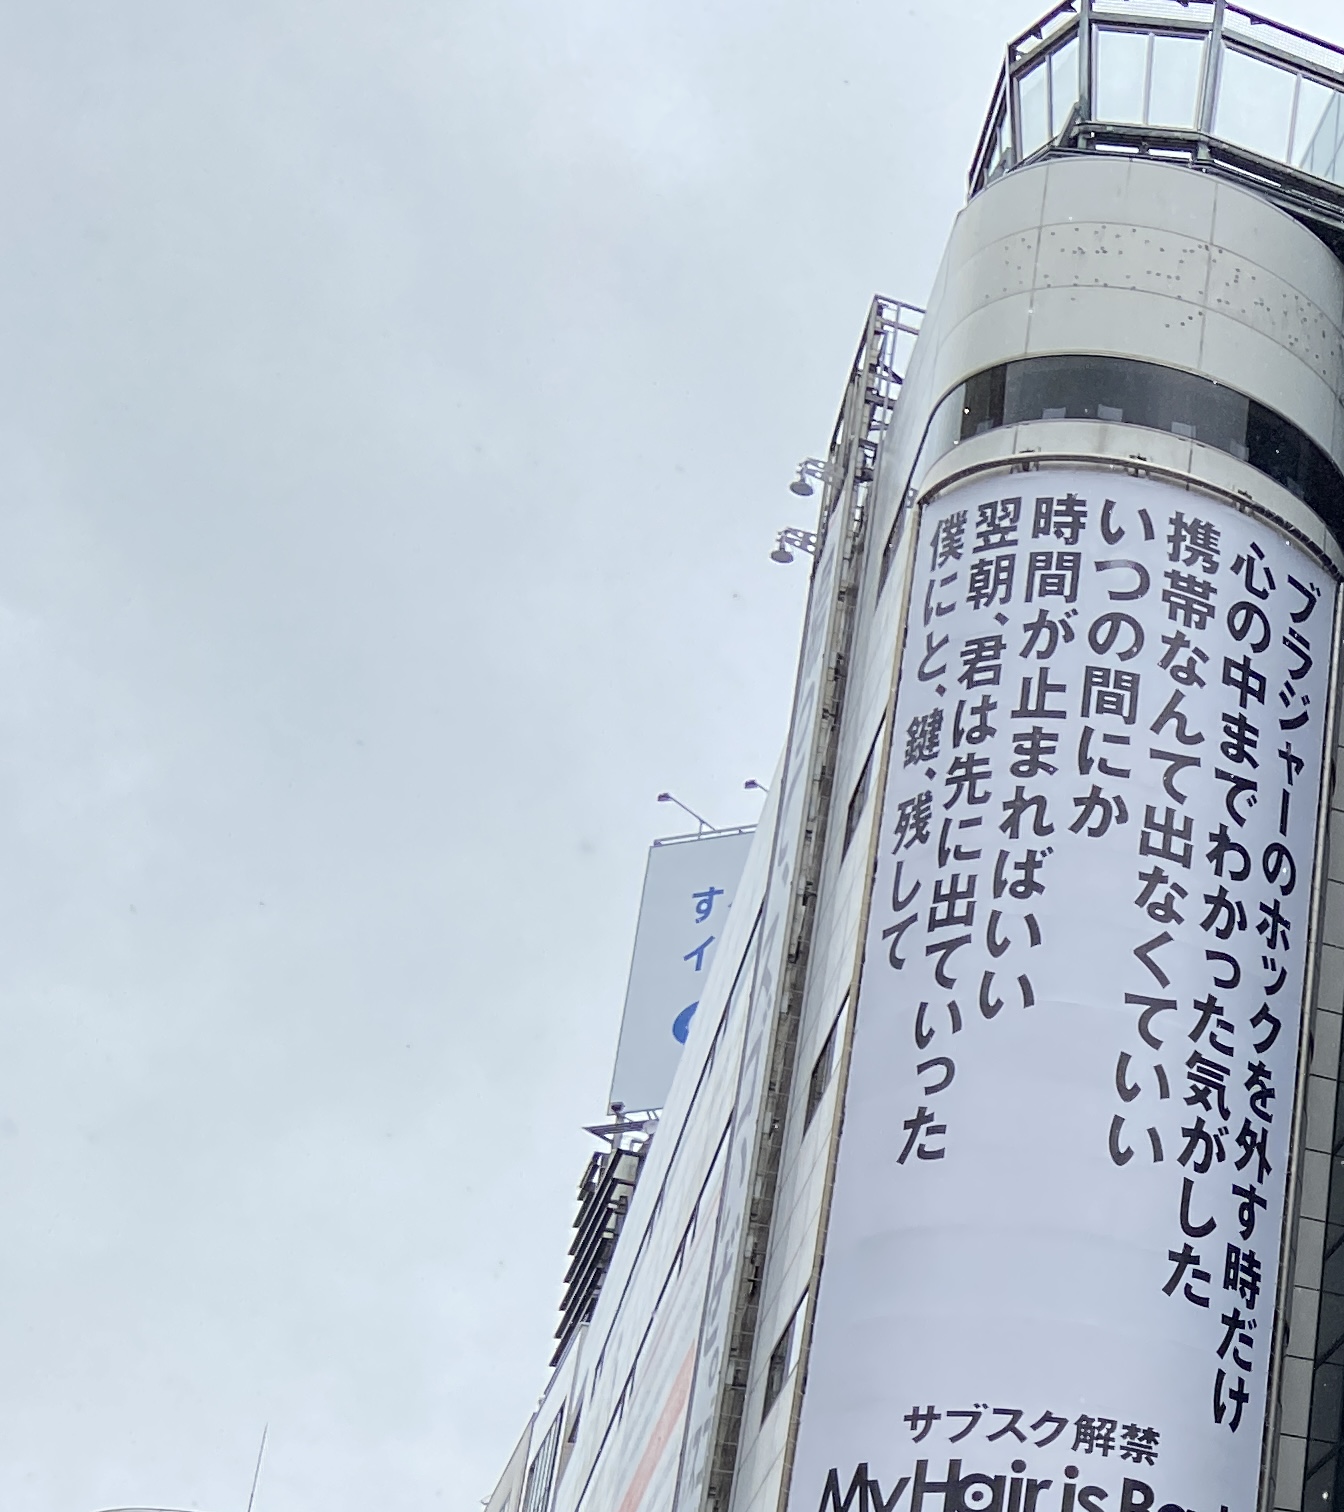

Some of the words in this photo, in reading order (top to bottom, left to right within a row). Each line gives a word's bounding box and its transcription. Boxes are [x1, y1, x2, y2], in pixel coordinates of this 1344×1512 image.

[881, 508, 968, 971] 僕にと、鍵、残して
[896, 495, 1023, 1165] 翌朝、君は先に出ていった
[979, 491, 1088, 1021] 時間が止まればいい
[1068, 497, 1155, 839] いつの間にか
[1107, 510, 1221, 1166] 携帯なんて出なくていい
[1162, 540, 1278, 1308] 心の中までわかった気がした
[1213, 572, 1321, 1433] ブラジャーのホックを外す時だけ
[903, 1402, 1162, 1467] サブスク解禁
